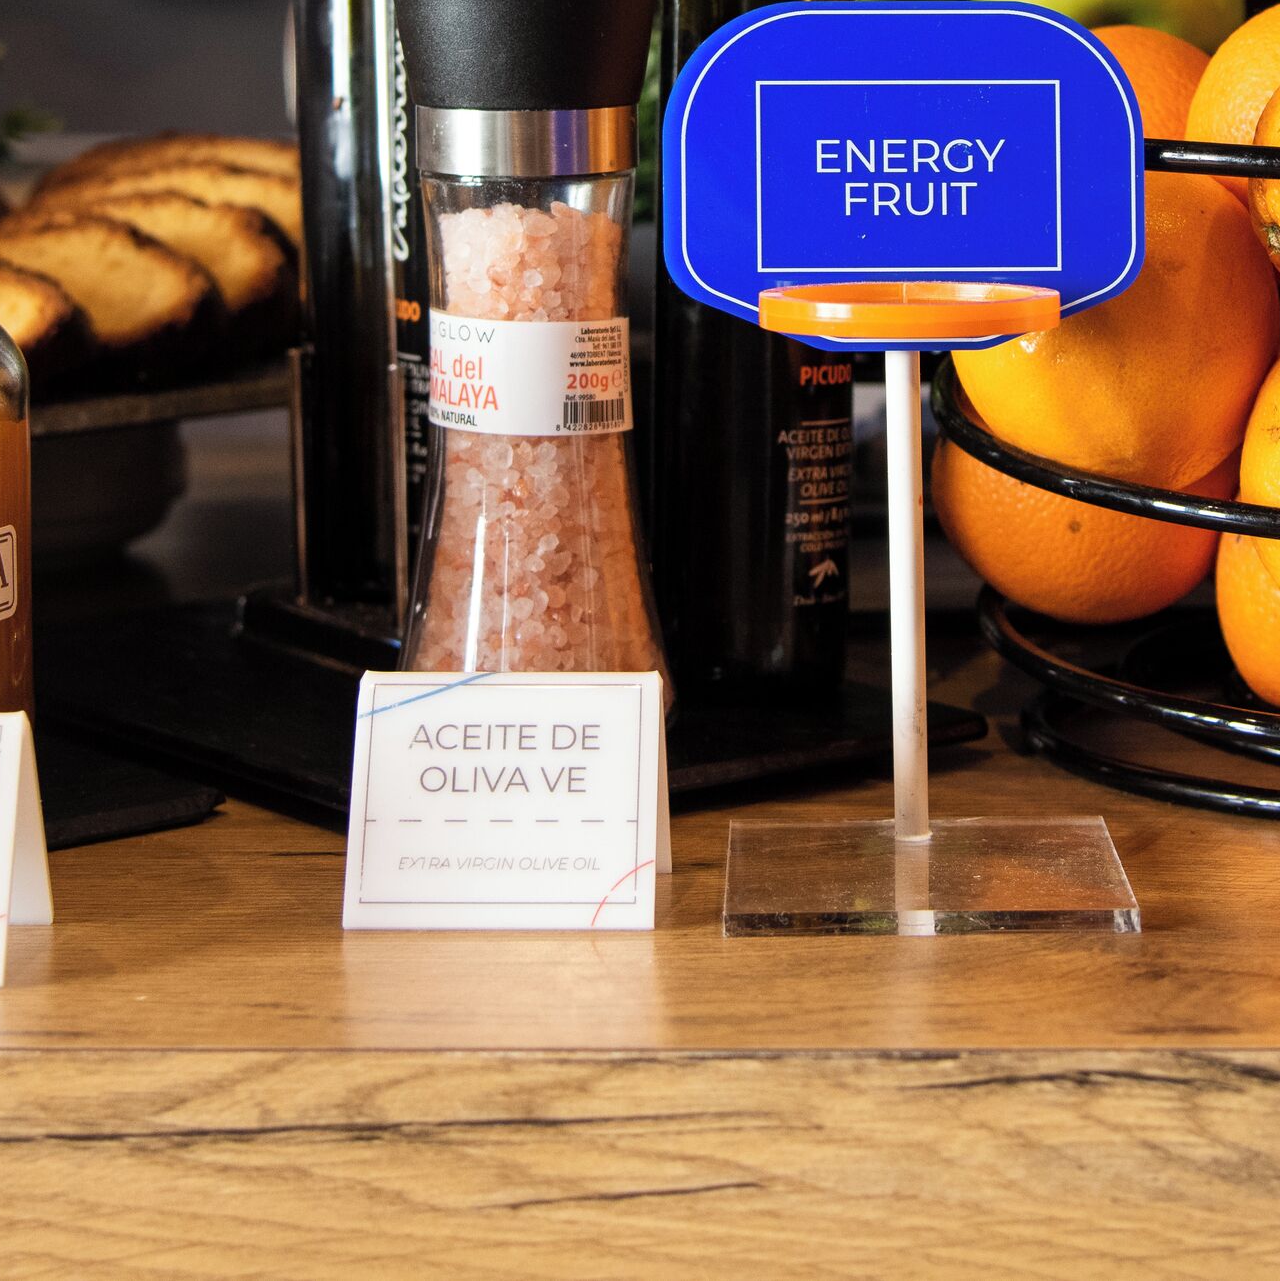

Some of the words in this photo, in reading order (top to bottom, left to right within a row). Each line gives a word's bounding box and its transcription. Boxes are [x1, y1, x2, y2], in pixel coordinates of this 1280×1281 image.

[815, 138, 1006, 174] ENERGY
[844, 182, 978, 216] FRUIT
[453, 353, 483, 380] del
[567, 372, 609, 392] 200g
[441, 408, 478, 426] NATURAL
[778, 429, 824, 445] ACEITE
[786, 445, 833, 461] VIRGEN
[409, 724, 538, 750] ACEITE
[551, 724, 601, 750] DE
[420, 766, 530, 793] OLIVA
[541, 766, 587, 793] VE
[398, 856, 451, 871] EXTRA
[456, 856, 515, 871] VIRGIN
[519, 856, 569, 871] OLIVE
[573, 856, 601, 871] OIL
